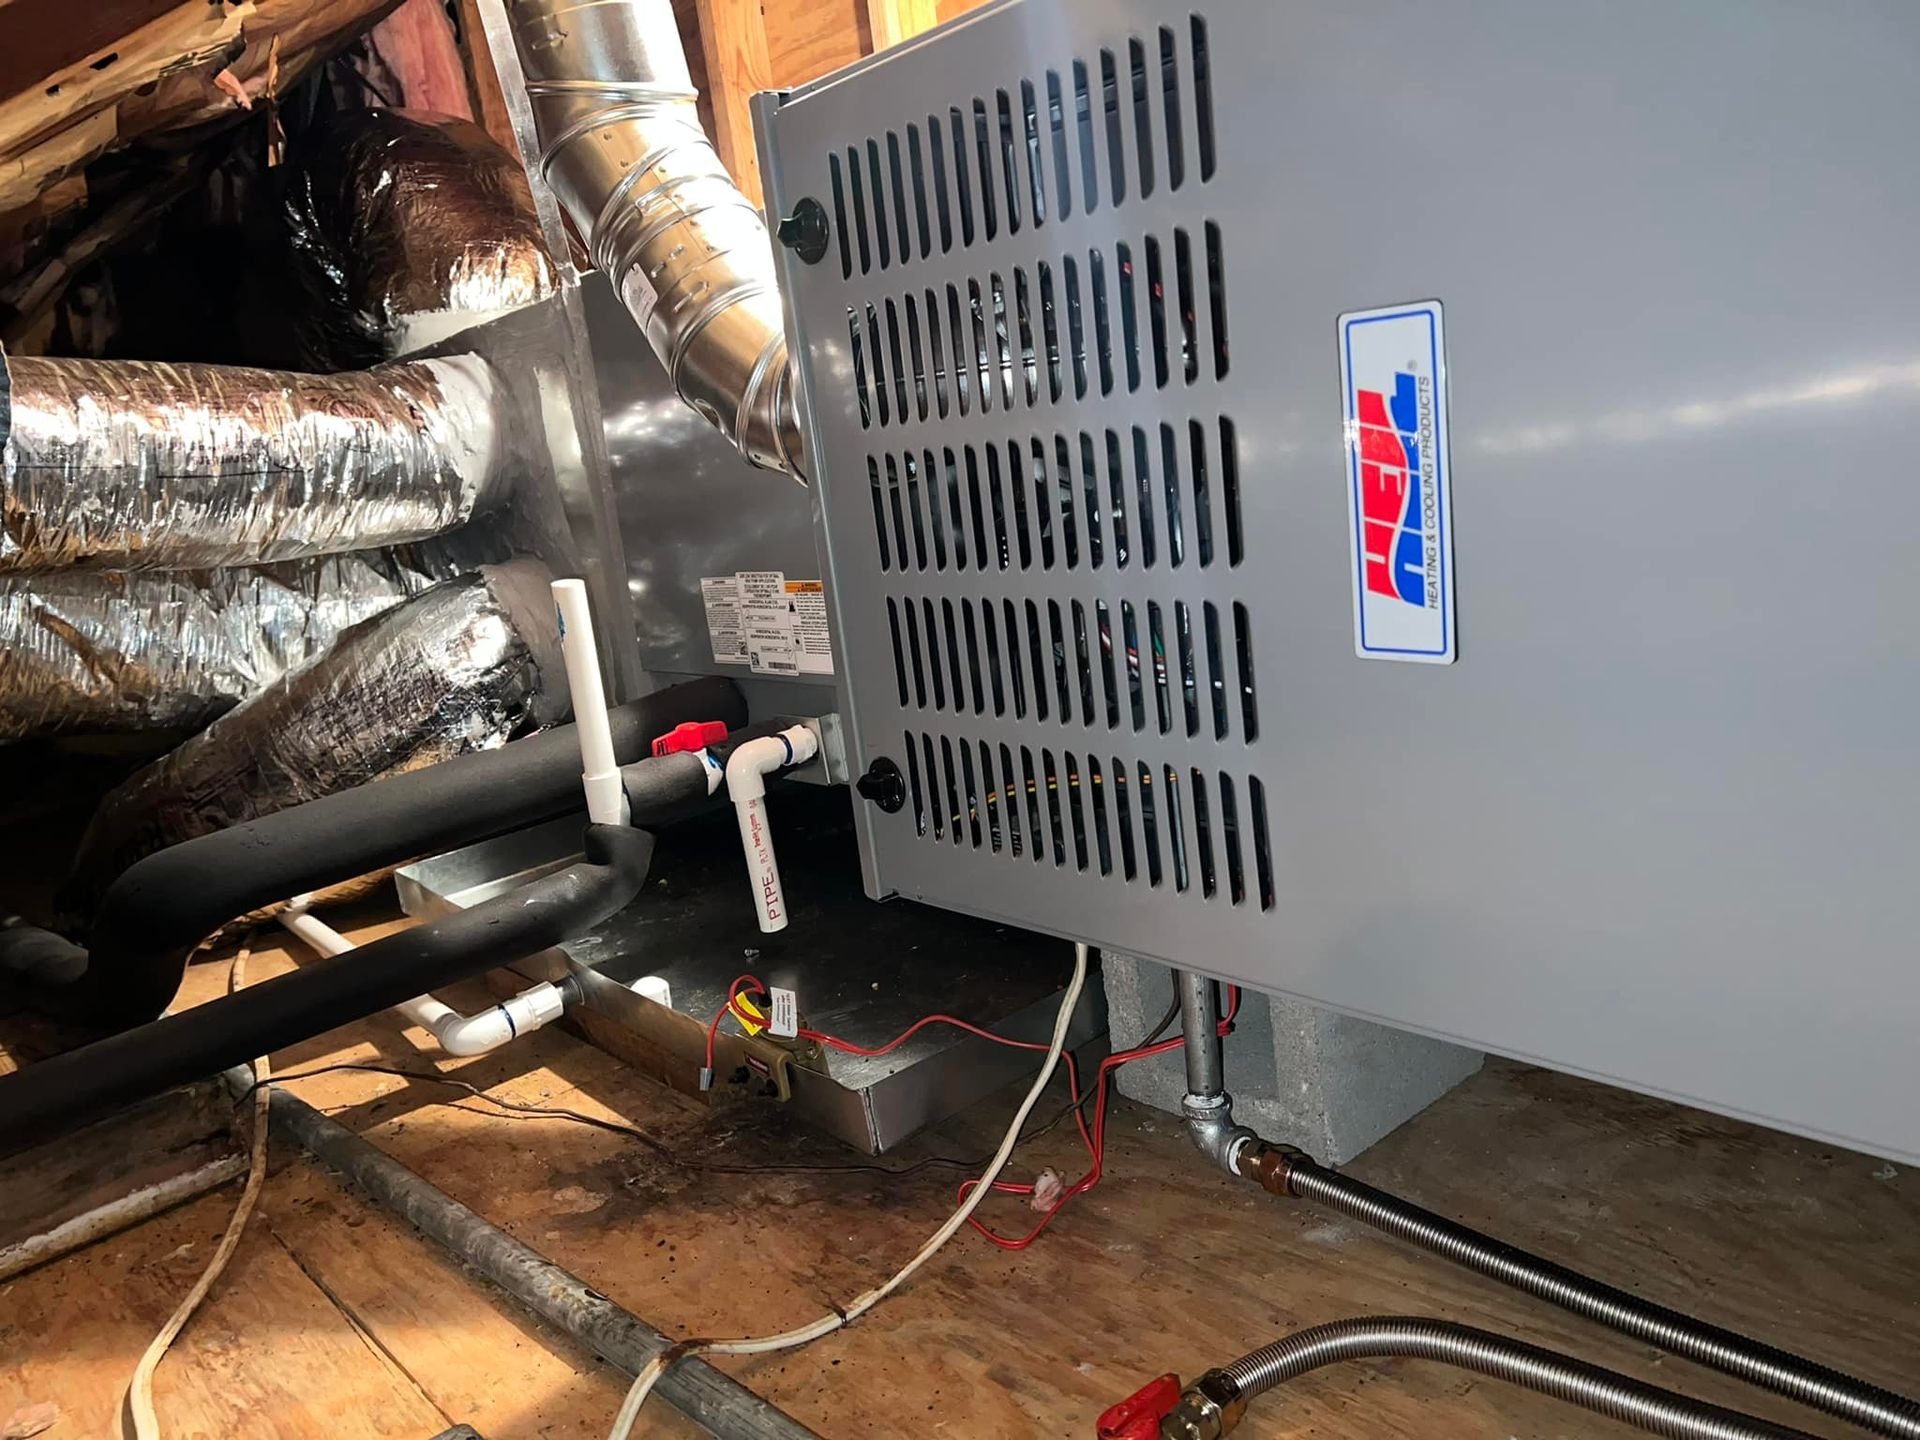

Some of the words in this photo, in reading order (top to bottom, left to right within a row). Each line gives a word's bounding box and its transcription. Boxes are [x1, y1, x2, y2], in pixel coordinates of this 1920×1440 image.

[1419, 376, 1433, 461] PRODUCTS
[1357, 371, 1425, 608] HEIL
[1422, 463, 1435, 530] COOLING
[1425, 534, 1436, 545] &
[1426, 547, 1439, 610] HEATING
[762, 871, 781, 921] PIPE
